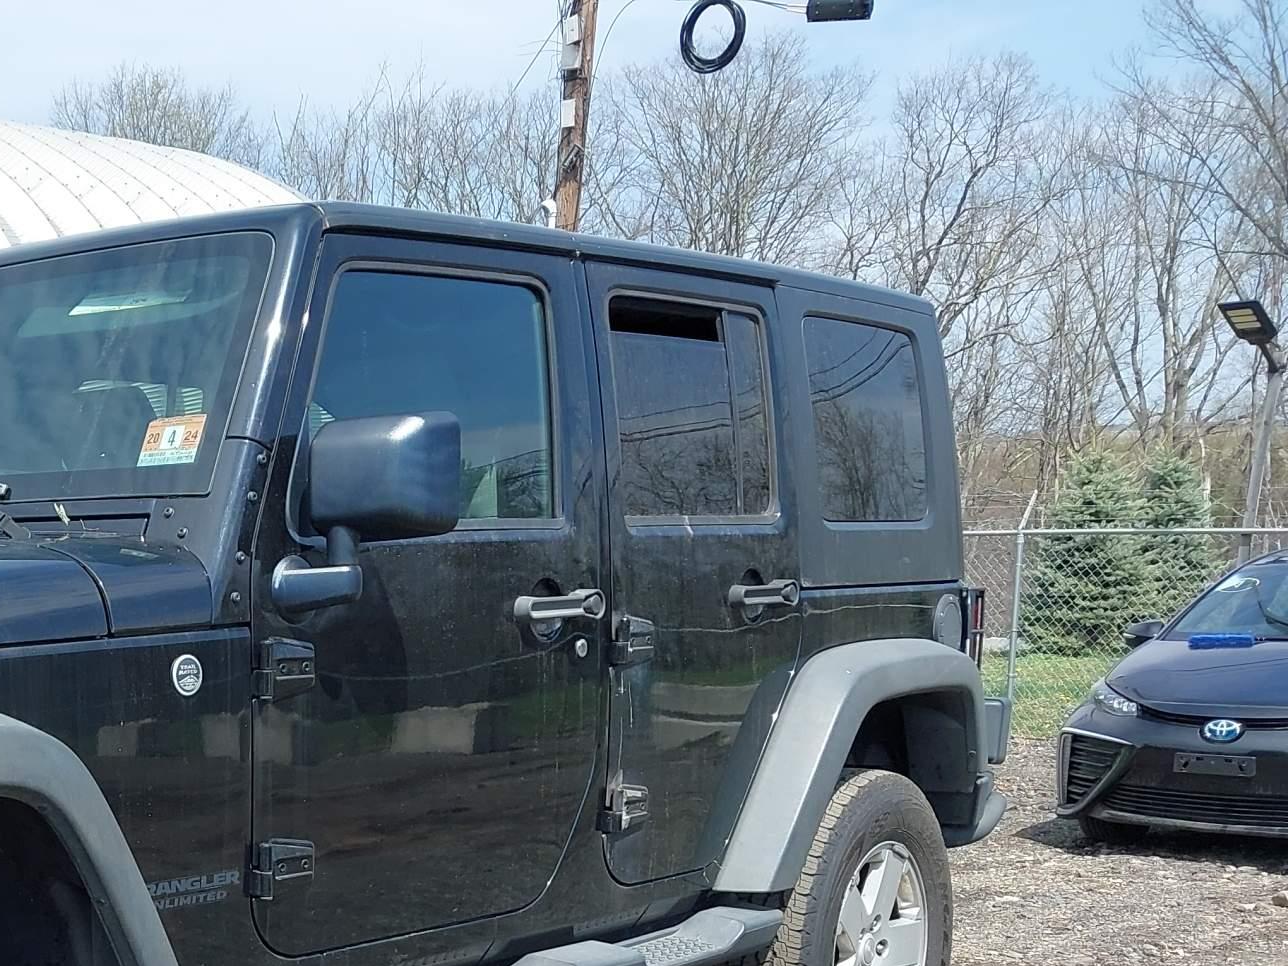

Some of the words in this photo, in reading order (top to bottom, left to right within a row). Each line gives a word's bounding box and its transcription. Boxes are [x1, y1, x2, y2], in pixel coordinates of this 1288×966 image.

[147, 432, 160, 445] 20
[167, 429, 177, 447] 4
[183, 430, 199, 441] 24
